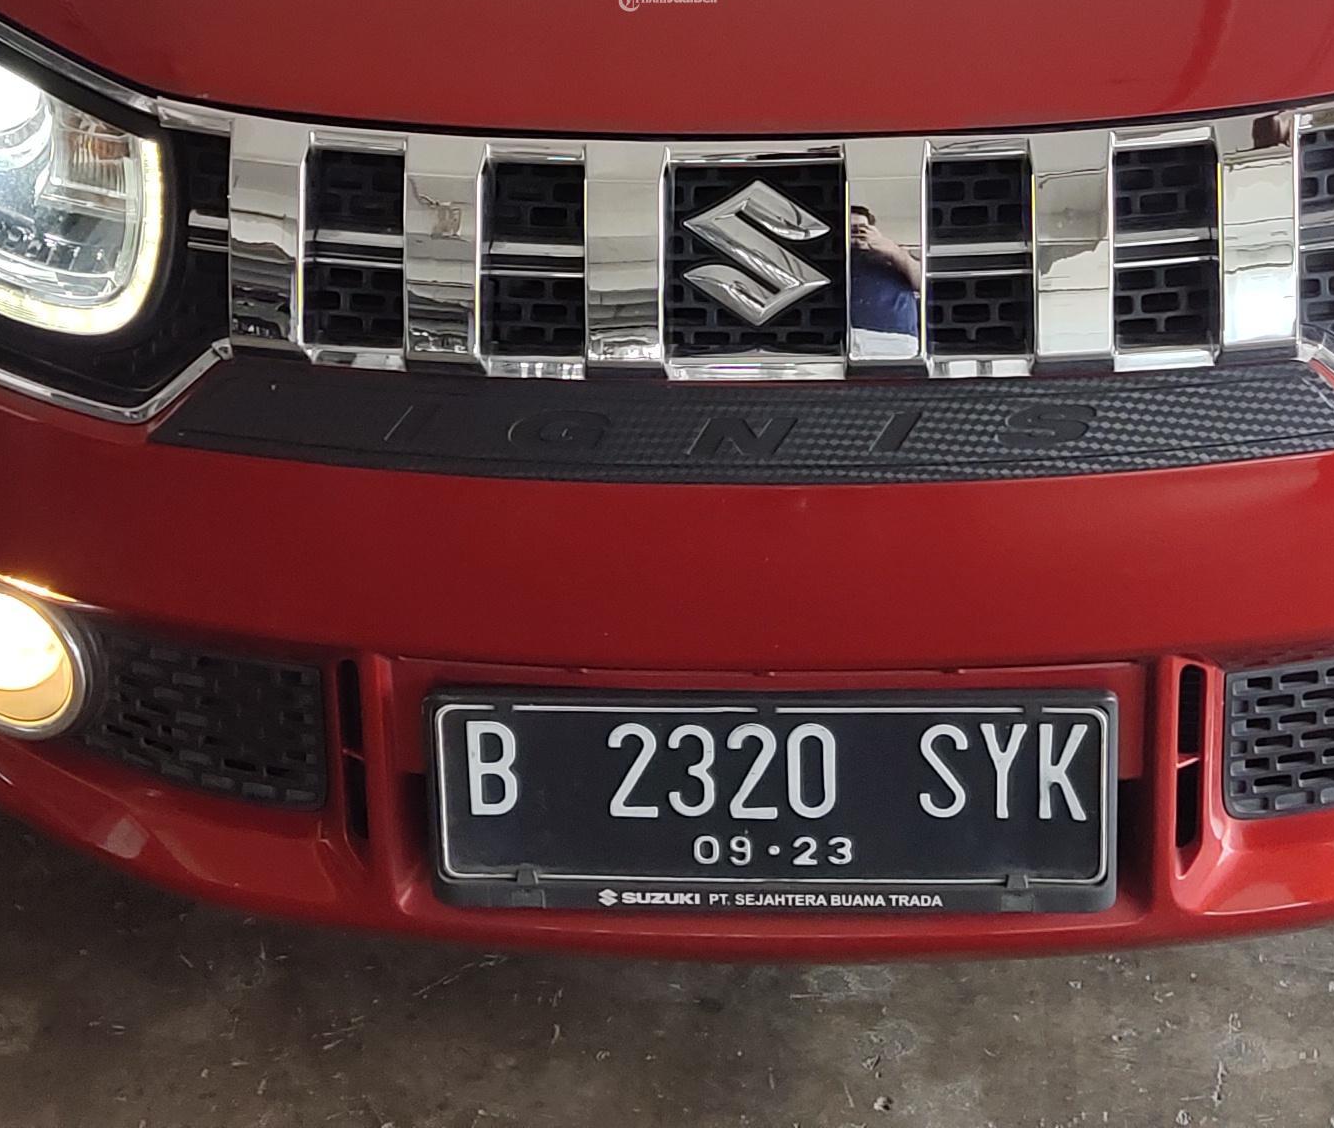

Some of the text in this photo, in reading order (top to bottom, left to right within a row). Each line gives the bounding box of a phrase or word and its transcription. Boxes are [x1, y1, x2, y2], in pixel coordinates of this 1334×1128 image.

[383, 403, 1099, 456] IGNIS
[467, 721, 1088, 822] B 2320 SYK
[621, 891, 943, 907] SUZUKI PT. SEJAHTERA BUANA TRADA
